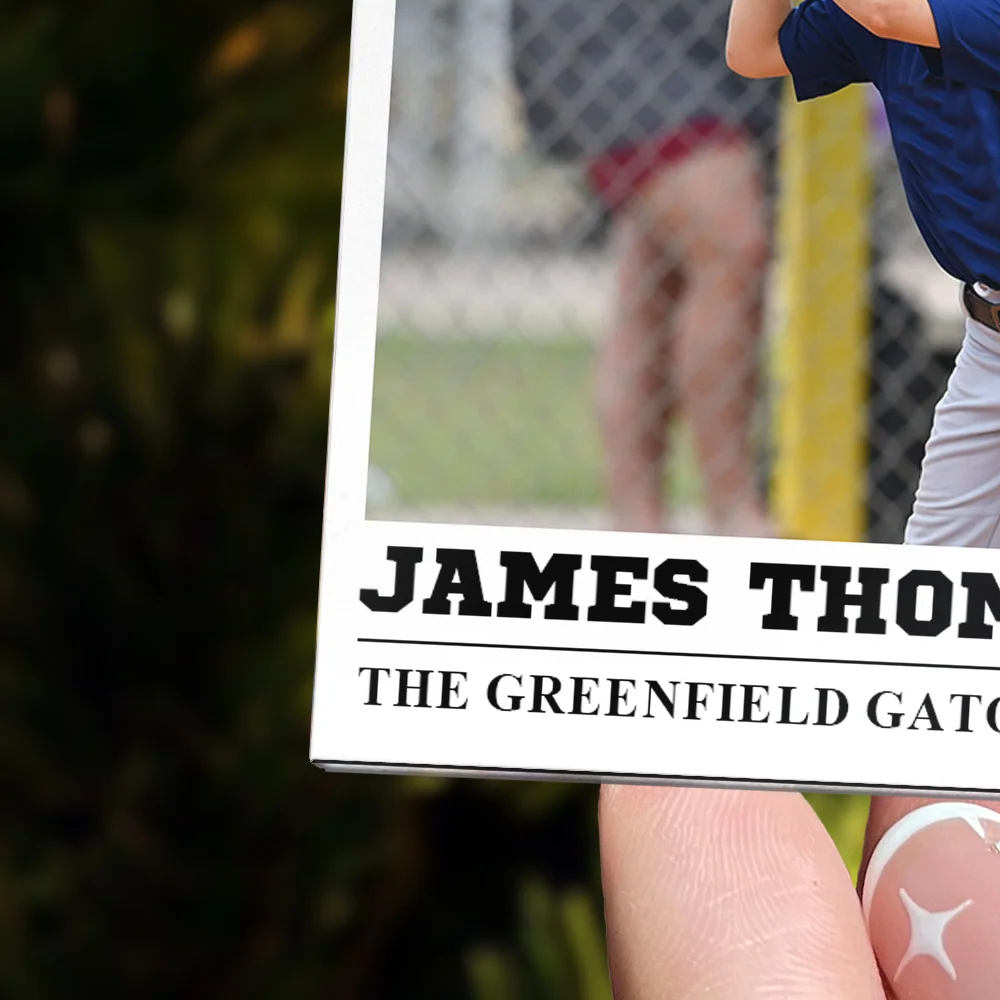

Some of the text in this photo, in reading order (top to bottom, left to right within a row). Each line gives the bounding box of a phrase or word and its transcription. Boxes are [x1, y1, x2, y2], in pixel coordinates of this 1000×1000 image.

[359, 545, 709, 627] JAMES
[358, 666, 468, 710] THE
[486, 673, 849, 727] GREENFIELD
